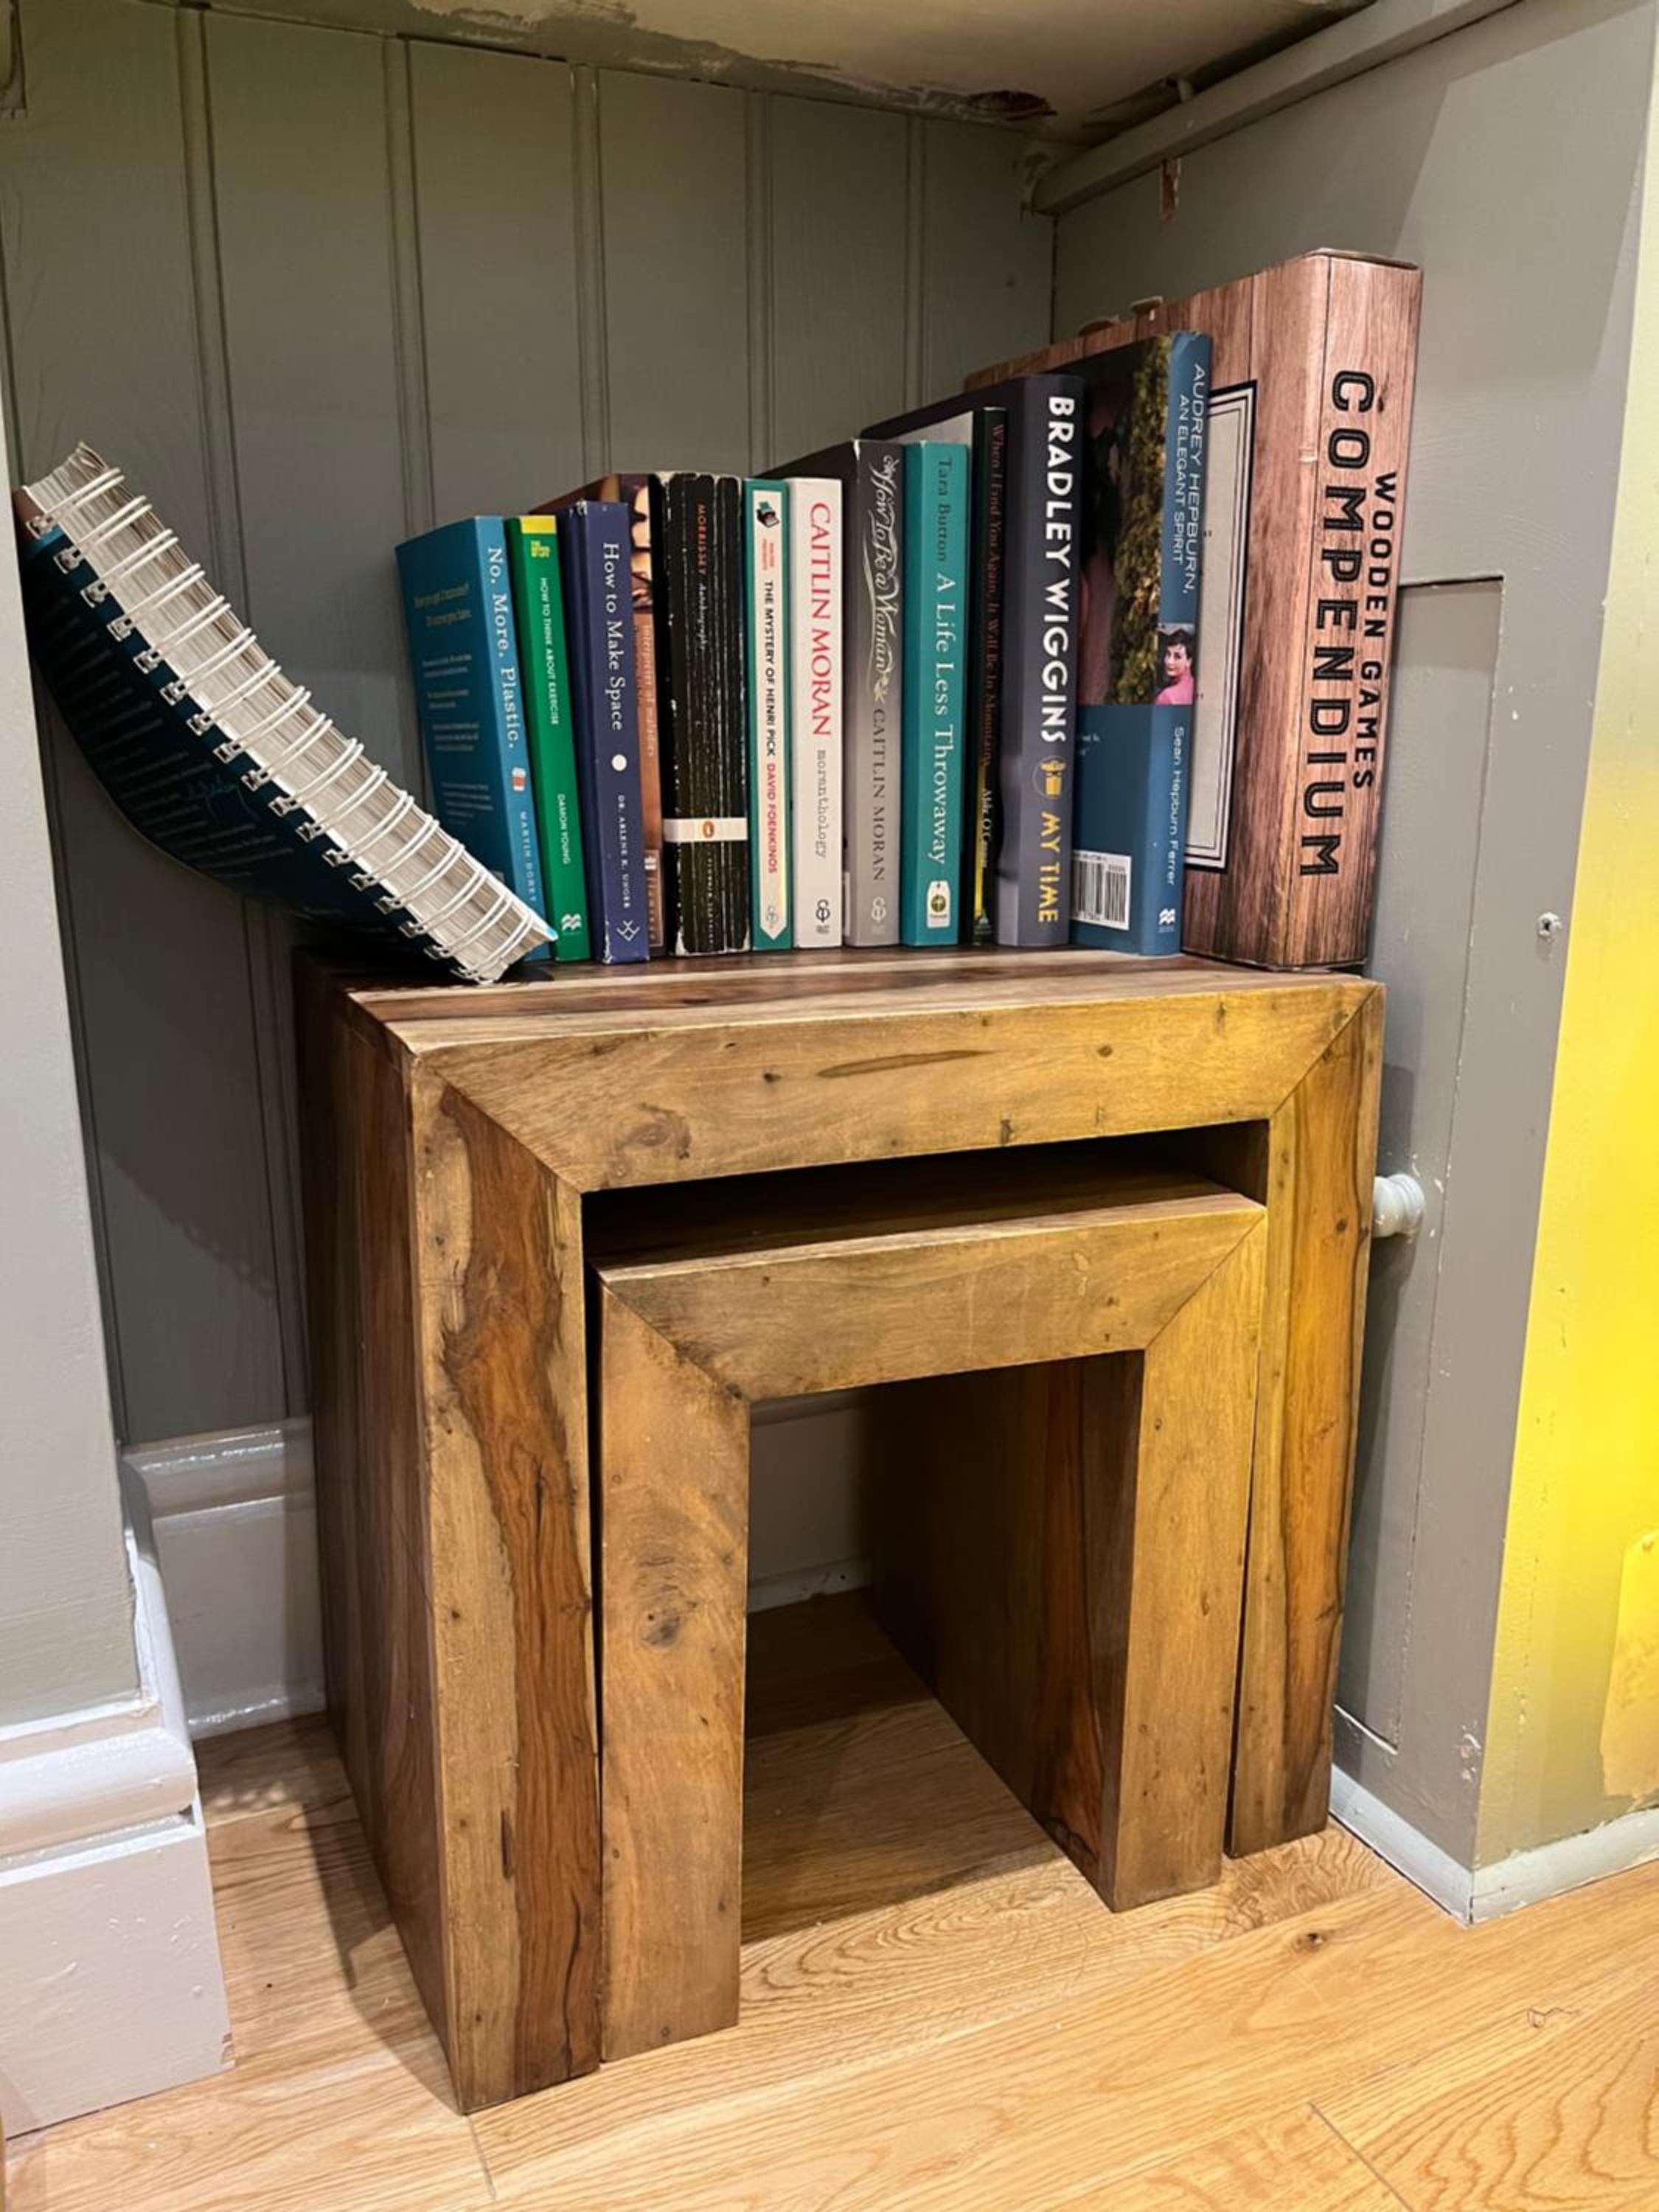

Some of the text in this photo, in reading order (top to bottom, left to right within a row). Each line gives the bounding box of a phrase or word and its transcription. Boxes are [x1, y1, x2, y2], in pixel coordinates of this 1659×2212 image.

[870, 460, 897, 511] How
[990, 424, 1004, 468] When
[1172, 394, 1190, 564] AN ELEGANT SPIRIT
[1182, 364, 1206, 594] AUDREY HEPBURN,
[697, 504, 708, 575] MORRISSEY
[936, 457, 953, 563] Tara Button
[989, 521, 1002, 547] You
[990, 482, 1004, 515] Find
[763, 581, 774, 605] THE
[987, 603, 1001, 613] It
[1041, 397, 1074, 742] BRADLEY WIGGINS
[487, 546, 522, 749] No. More. Plastic.
[539, 577, 560, 726] HOW TO THINK ABOUT EXERCISE
[602, 542, 626, 731] How to Make Space
[764, 608, 776, 666] MYSTERY
[810, 502, 832, 736] CAITLIN MORAN
[874, 581, 899, 673] Woman
[987, 619, 999, 649] Will
[1299, 370, 1374, 877] COMPENDIUM
[1352, 472, 1397, 790] WOODEN GAMES
[765, 667, 776, 686] OF
[765, 689, 776, 726] HENRI
[927, 573, 957, 866] A Life Less Throwaway
[985, 675, 998, 689] In
[766, 728, 777, 757] PICK
[557, 793, 572, 866] DAMON YOUNG
[617, 794, 626, 813] DR.
[619, 815, 628, 856] ARLENE
[766, 762, 779, 874] DAVID FOENKINOS
[815, 749, 830, 859] moranthology
[872, 708, 886, 881] CAITLIN MORAN
[1166, 726, 1185, 886] Sean Hepburn Ferrer
[519, 811, 538, 903] MARTIN DOREY
[1037, 812, 1062, 923] MY TIME
